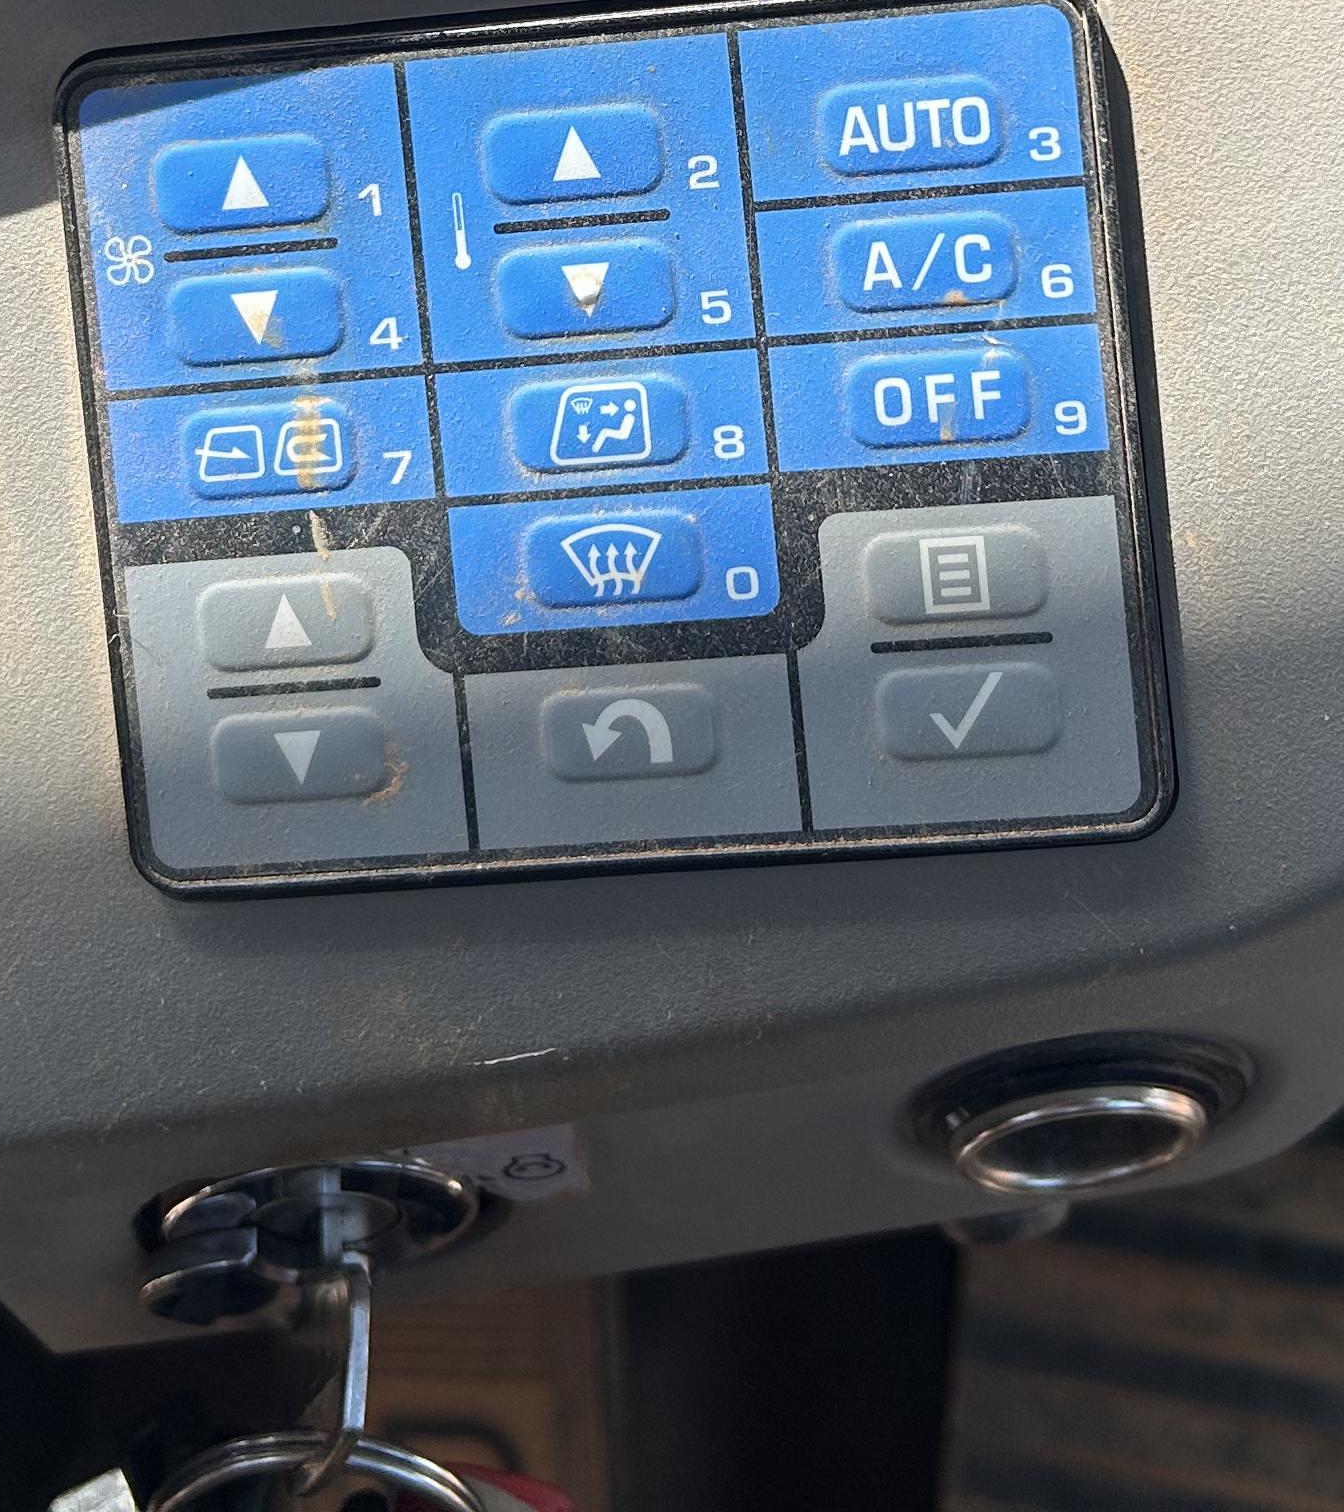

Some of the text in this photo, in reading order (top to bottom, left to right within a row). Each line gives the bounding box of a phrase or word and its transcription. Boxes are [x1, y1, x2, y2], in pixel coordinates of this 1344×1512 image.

[839, 96, 992, 157] AUTO
[1029, 126, 1062, 162] 3
[687, 154, 720, 190] 2
[358, 183, 382, 217] 1
[863, 233, 994, 290] A/C
[1041, 263, 1074, 299] 6
[700, 289, 732, 325] 5
[369, 317, 403, 351] 4
[874, 369, 1003, 427] OFF
[1055, 400, 1088, 436] 9
[713, 424, 746, 459] 8
[382, 450, 412, 485] 7
[725, 566, 759, 601] 0
